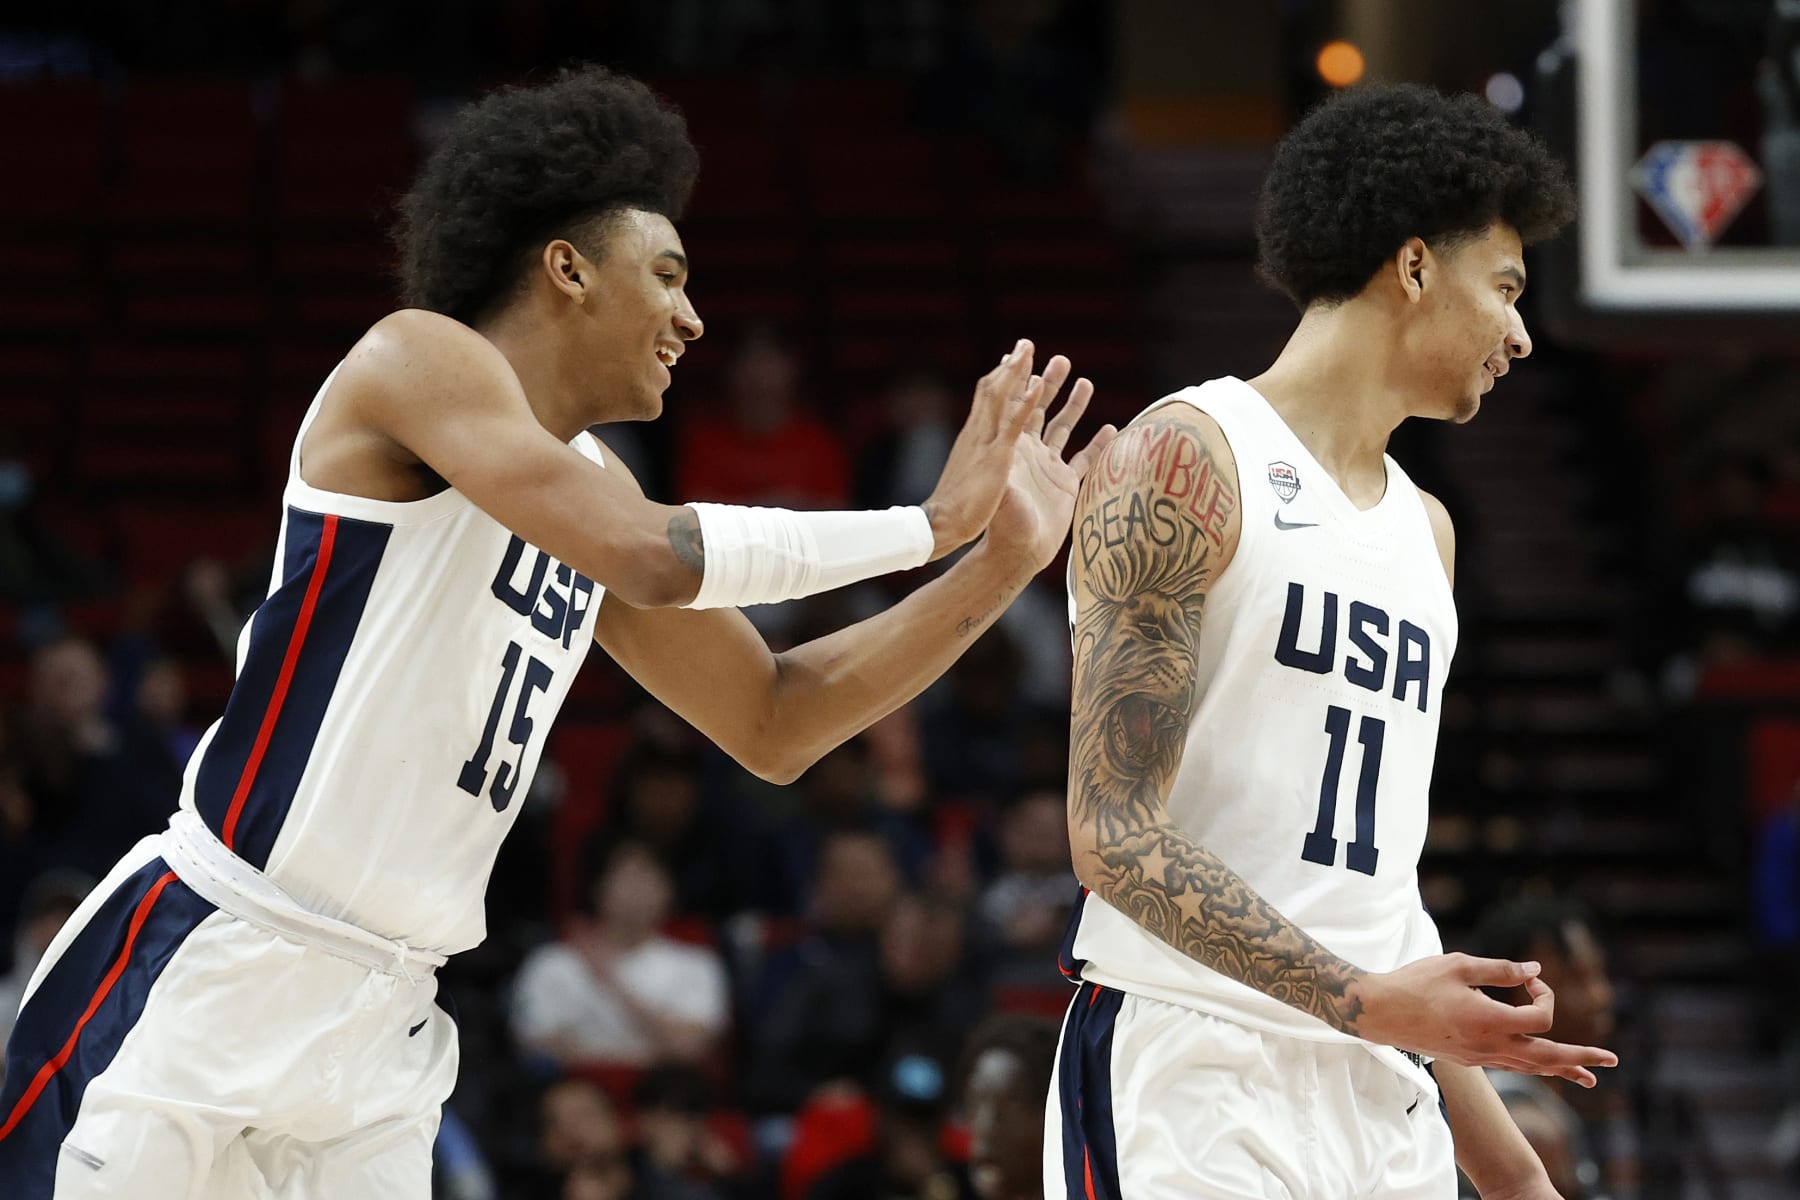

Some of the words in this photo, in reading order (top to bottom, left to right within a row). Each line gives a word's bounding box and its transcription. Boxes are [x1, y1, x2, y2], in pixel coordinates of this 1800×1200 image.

[1079, 490, 1207, 569] BEAST
[1271, 467, 1294, 481] USA
[1274, 581, 1431, 713] USA
[456, 640, 554, 813] 15
[1301, 705, 1386, 877] 11
